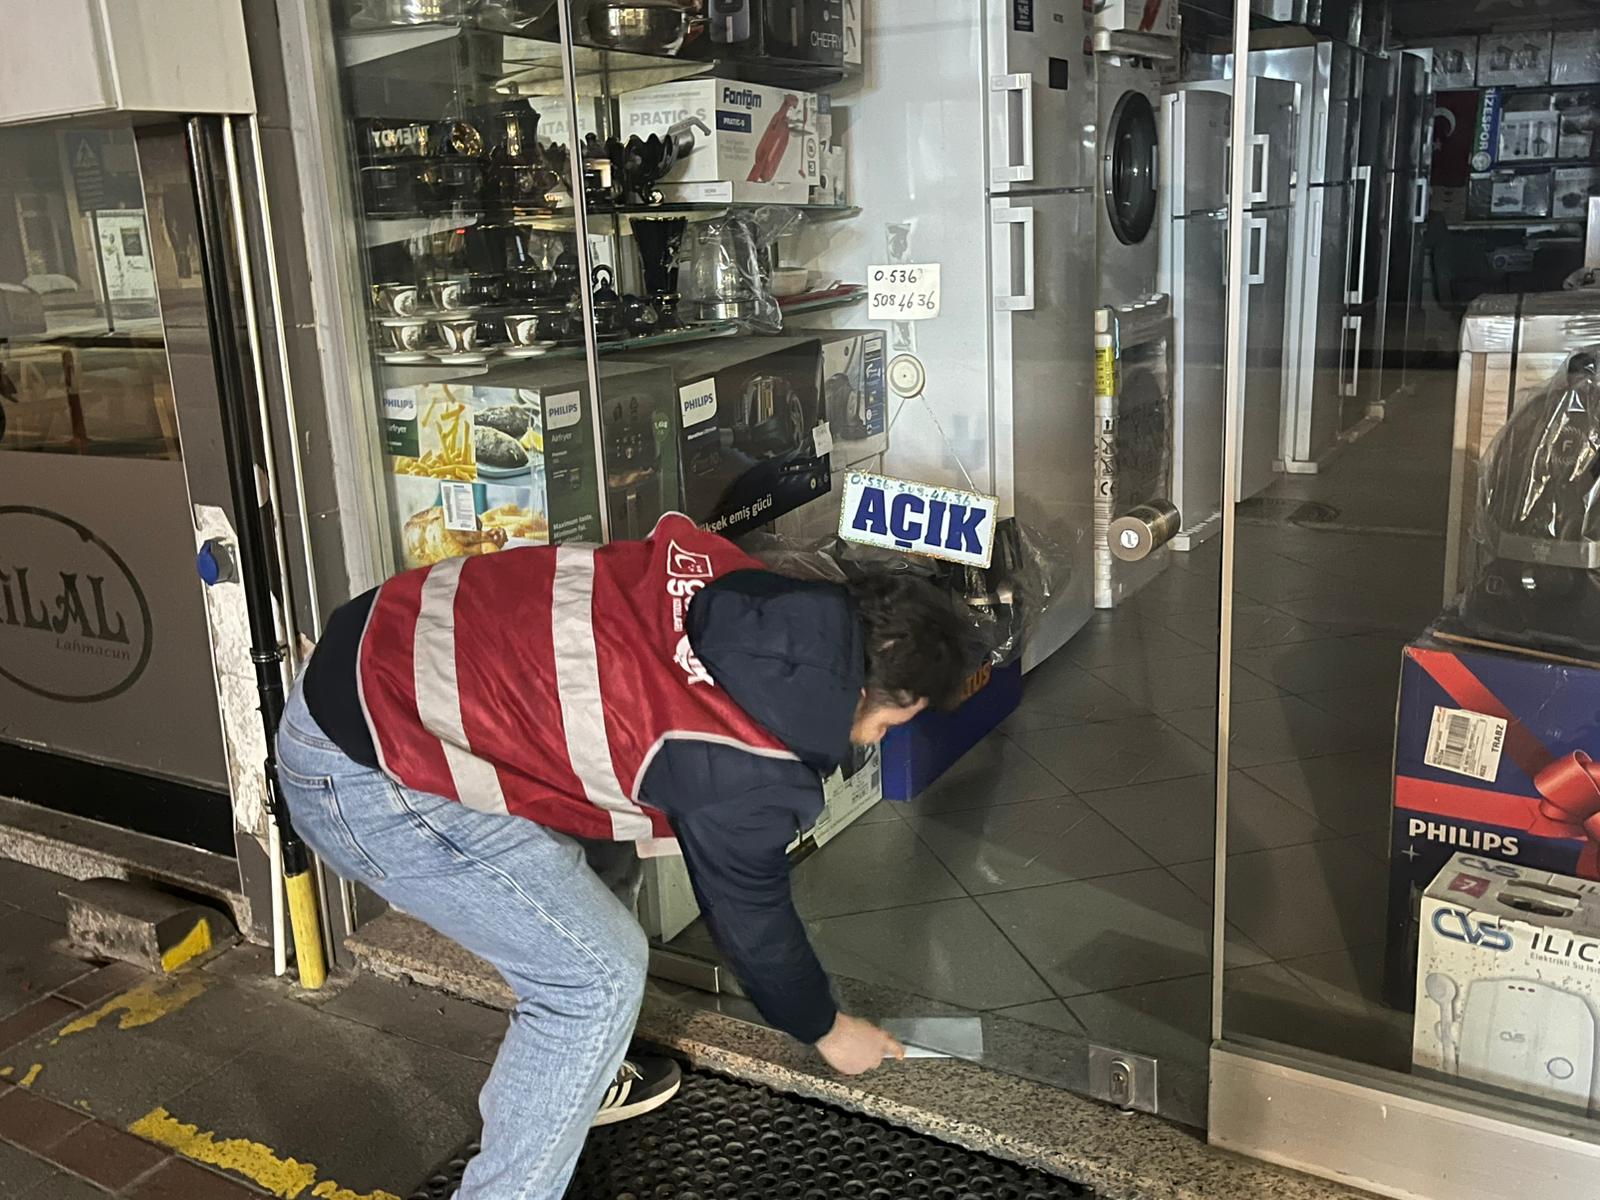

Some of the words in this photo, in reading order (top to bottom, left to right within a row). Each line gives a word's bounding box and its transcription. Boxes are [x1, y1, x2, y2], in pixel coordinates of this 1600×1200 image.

[549, 403, 578, 417] PHILIPS
[684, 392, 714, 412] PHILIPS
[551, 432, 573, 443] Airfryer
[729, 505, 751, 521] emiş
[752, 493, 773, 518] gücü
[852, 486, 987, 555] AÇIK
[56, 638, 130, 661] Lahmacun
[1491, 724, 1504, 753] TRABZ
[1408, 818, 1519, 857] PHILIPS
[1457, 856, 1521, 879] CVS
[1431, 906, 1514, 952] CVS
[1531, 932, 1600, 966] ILIC
